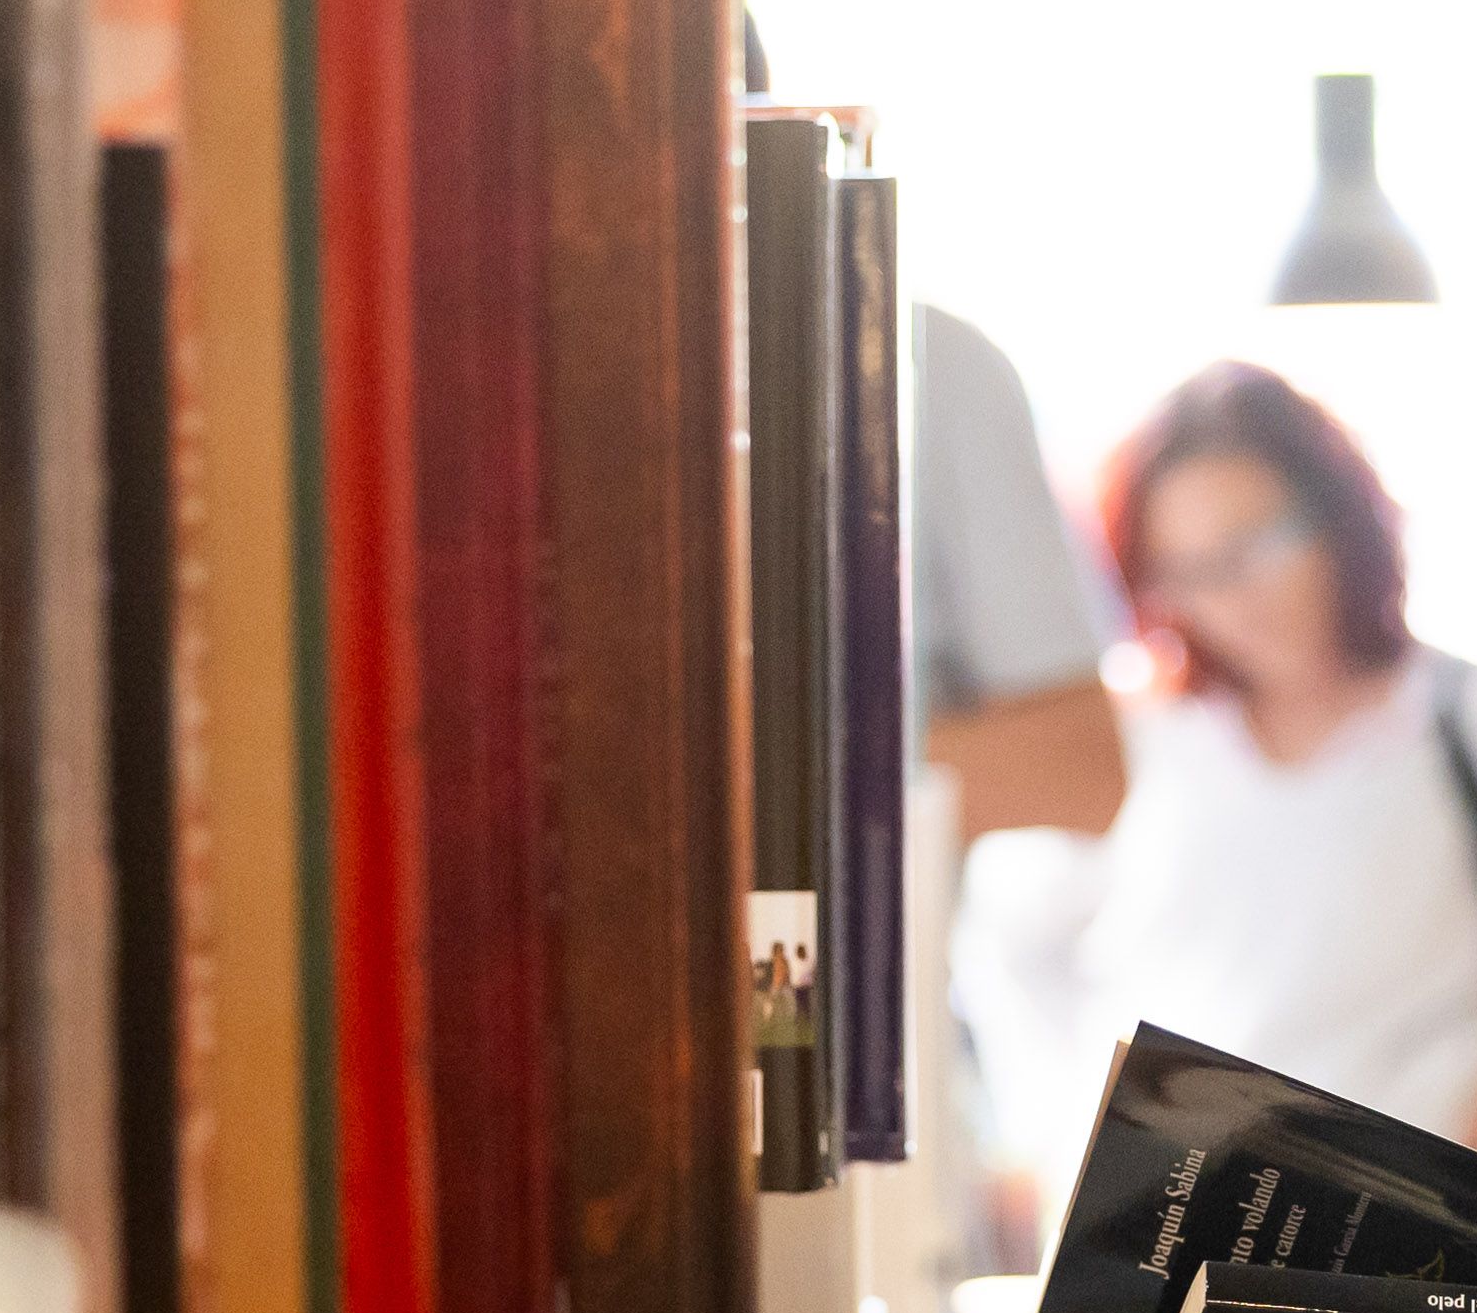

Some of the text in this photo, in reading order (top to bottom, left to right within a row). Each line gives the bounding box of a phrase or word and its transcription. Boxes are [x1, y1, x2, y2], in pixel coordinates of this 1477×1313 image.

[1138, 1148, 1207, 1280] Joaquín Sabina
[1238, 1167, 1281, 1232] volando
[1275, 1203, 1307, 1257] catorce
[1427, 1294, 1465, 1311] pelo
